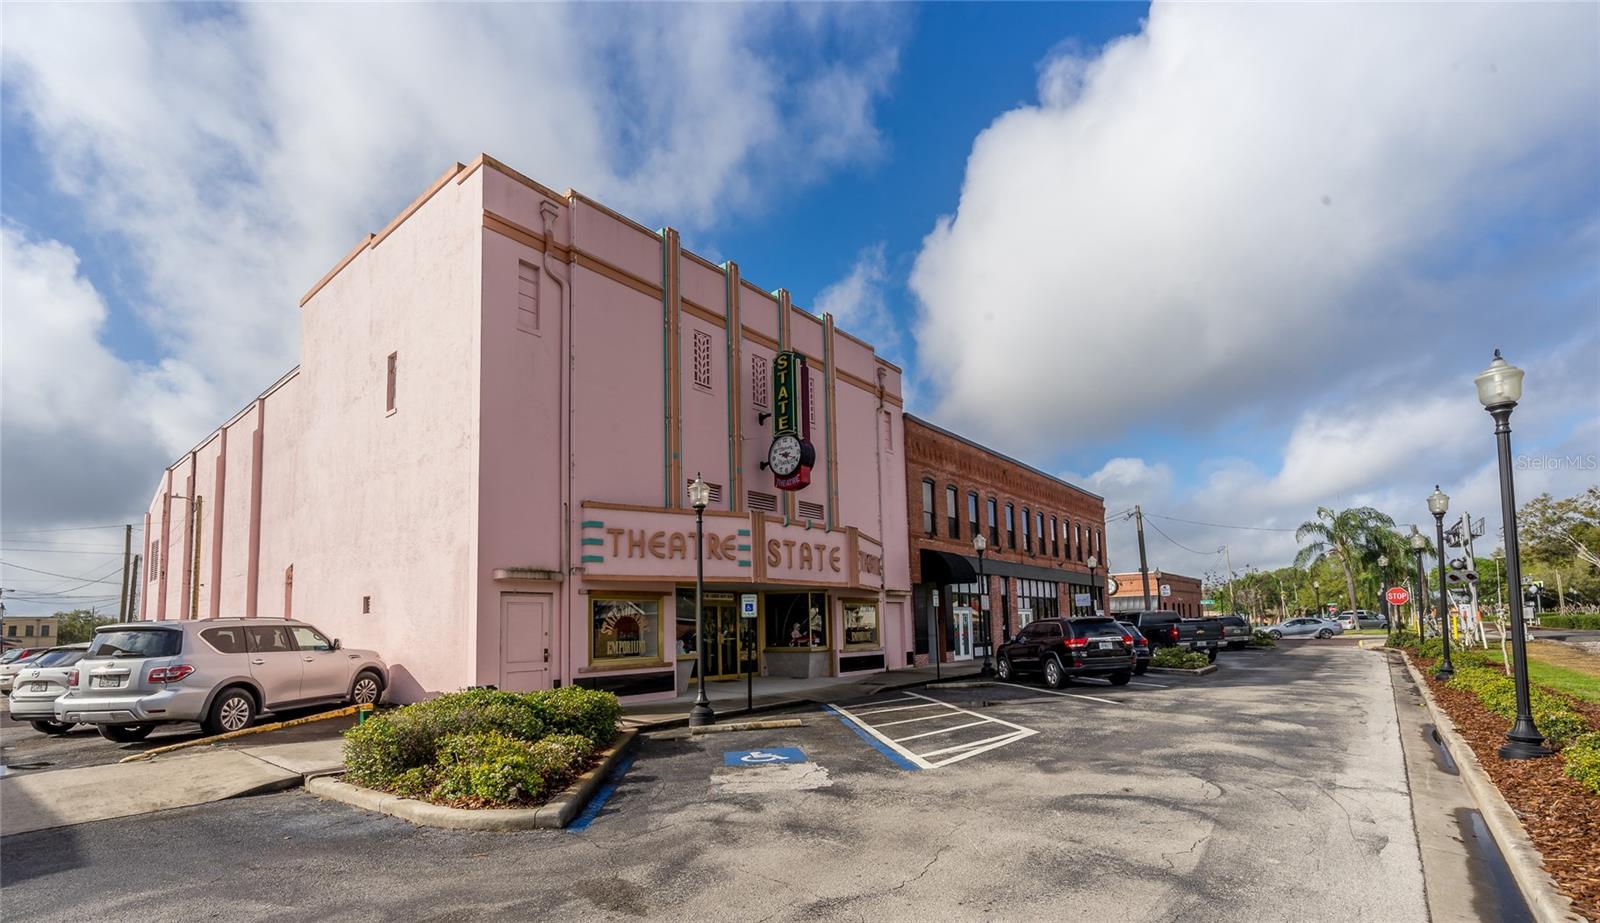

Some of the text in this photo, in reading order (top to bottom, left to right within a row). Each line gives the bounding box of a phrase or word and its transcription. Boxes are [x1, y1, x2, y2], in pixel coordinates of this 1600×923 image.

[777, 355, 789, 431] STATE
[606, 527, 737, 561] THEATRE
[767, 538, 842, 573] STATE
[1388, 592, 1407, 600] STOP
[606, 640, 646, 655] EMPORIUM
